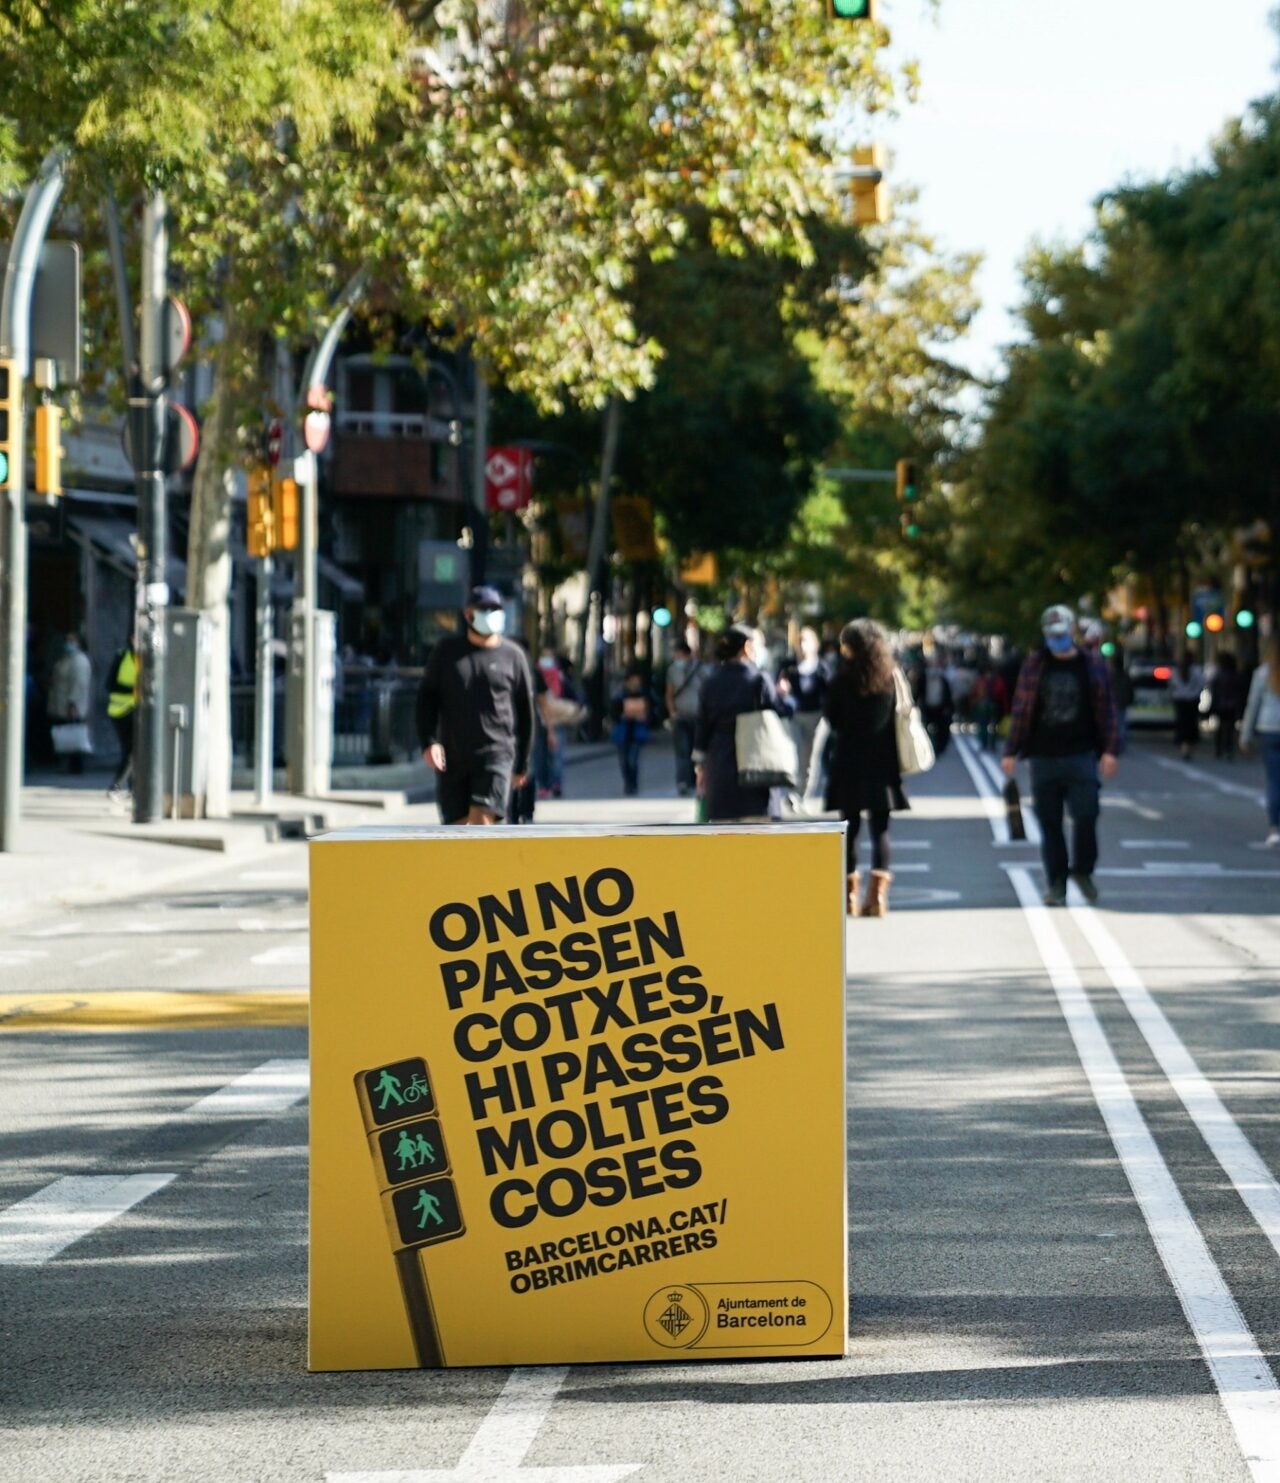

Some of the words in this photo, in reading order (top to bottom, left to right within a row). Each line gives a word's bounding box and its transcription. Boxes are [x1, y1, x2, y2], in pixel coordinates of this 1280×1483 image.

[429, 889, 529, 952] ON
[535, 867, 635, 930] NO
[440, 911, 685, 1010] PASSEN
[453, 965, 723, 1062] COTXES,
[465, 1061, 534, 1120] HI
[542, 1004, 785, 1102] PASSEN
[476, 1076, 730, 1176] MOLTES
[489, 1139, 702, 1229] COSES
[506, 1199, 727, 1271] BARCELONA.CAT/
[510, 1229, 717, 1294] OBRIMCARRERS
[717, 1297, 788, 1312] Ajuntament
[791, 1296, 806, 1307] de
[717, 1311, 806, 1329] Barcelona
